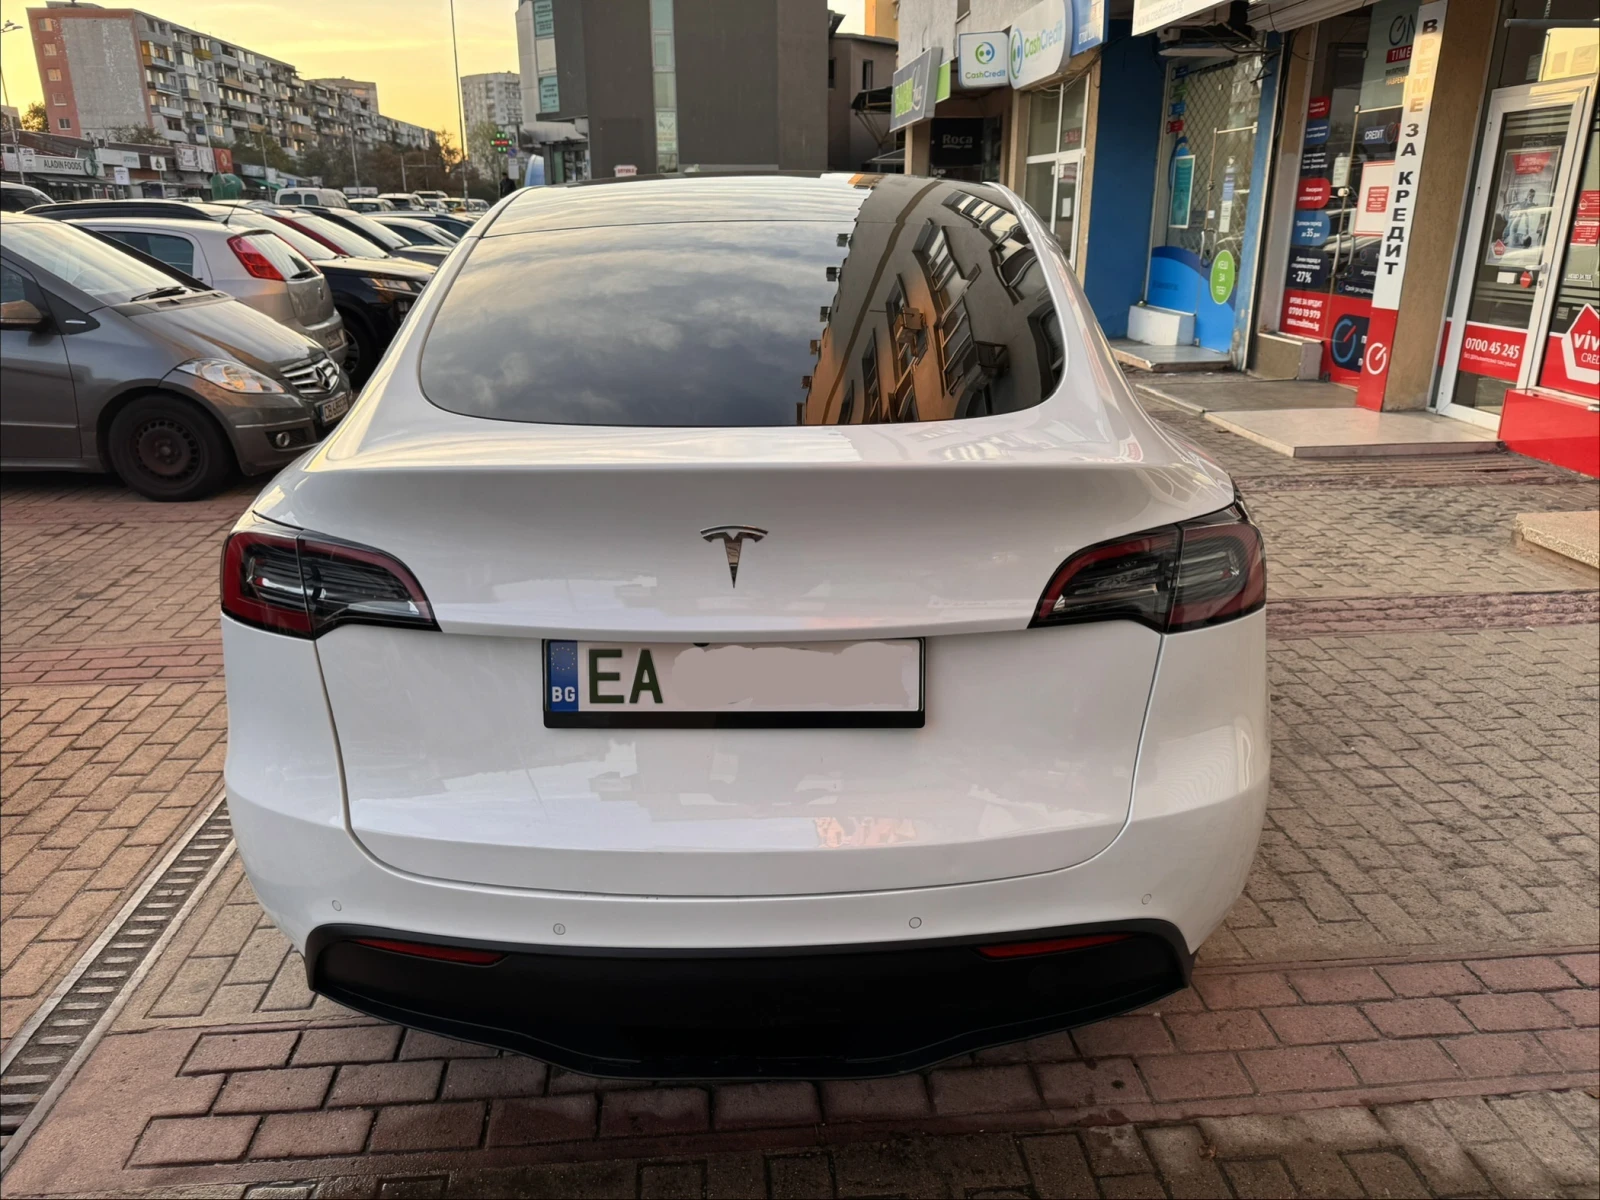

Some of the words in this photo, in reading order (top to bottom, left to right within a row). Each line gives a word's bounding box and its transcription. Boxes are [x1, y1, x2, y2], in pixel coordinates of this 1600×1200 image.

[1024, 19, 1062, 58] CashCredit
[1391, 47, 1411, 61] TIME
[965, 69, 1006, 79] CashCredit
[1409, 19, 1438, 113] ВРЕМЕ
[942, 134, 973, 144] Roca
[1364, 129, 1384, 140] CREDIT
[1401, 123, 1419, 157] ЗА
[44, 159, 64, 169] ALADIN
[64, 161, 82, 171] FOODS
[1384, 171, 1413, 275] КРЕДИТ
[1288, 306, 1303, 316] 0700
[1465, 337, 1488, 352] 0700
[1489, 341, 1502, 355] 45
[1501, 343, 1520, 359] 245
[551, 686, 576, 703] BG
[588, 648, 664, 704] EA
